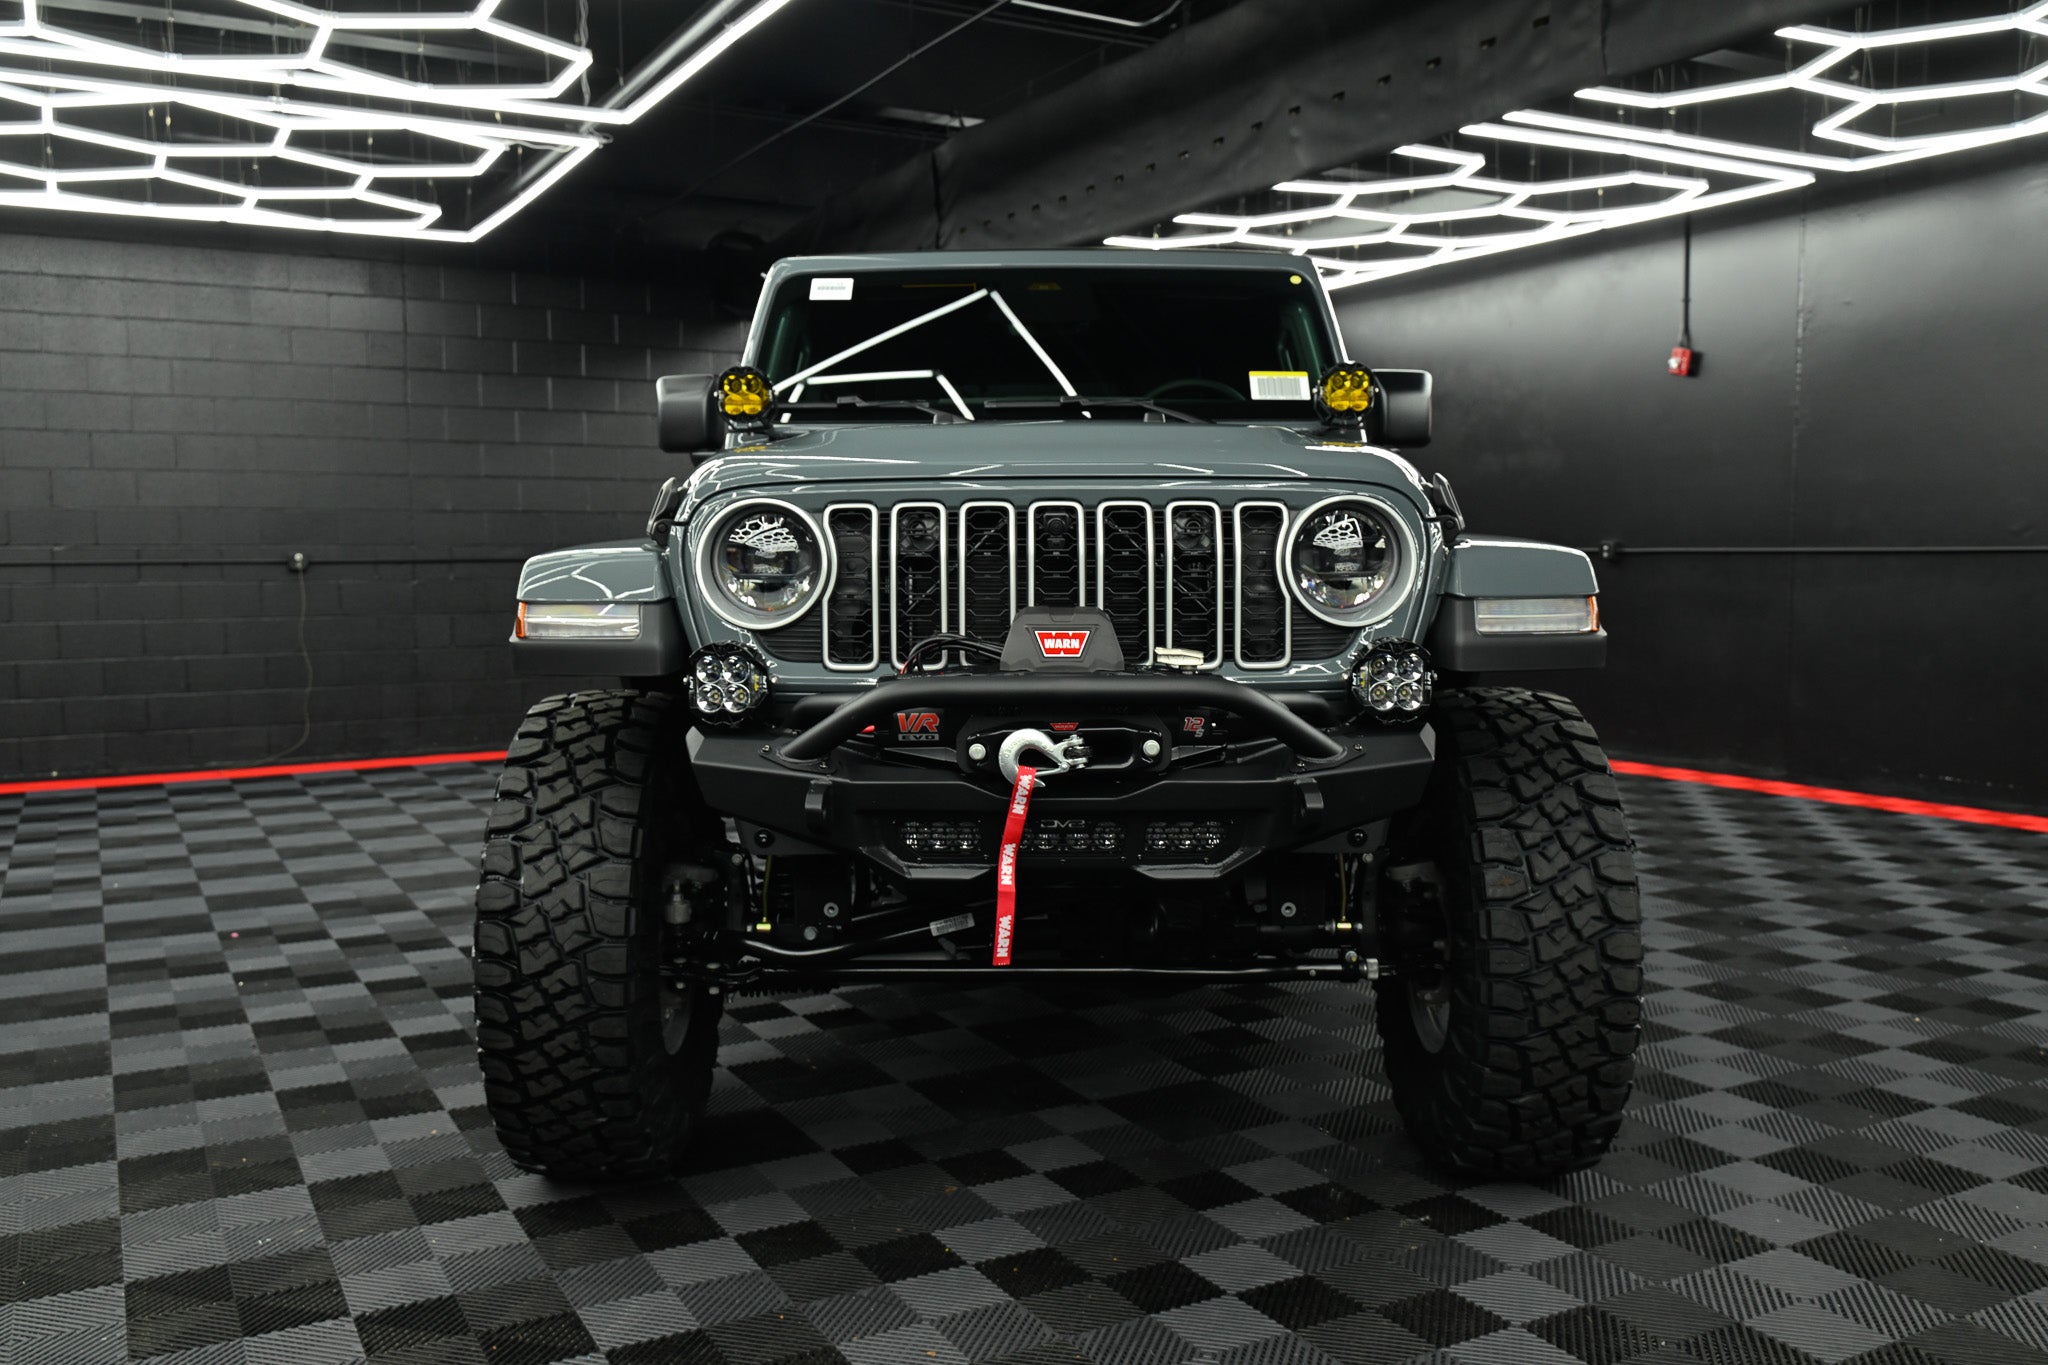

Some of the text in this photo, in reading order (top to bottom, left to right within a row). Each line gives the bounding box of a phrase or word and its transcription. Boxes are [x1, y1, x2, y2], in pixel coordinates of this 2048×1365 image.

[1043, 638, 1080, 649] WARN
[897, 712, 940, 733] VR
[1184, 716, 1205, 731] 12
[1012, 774, 1033, 815] WARN
[1001, 843, 1017, 885] WARN
[996, 915, 1012, 957] WARN
